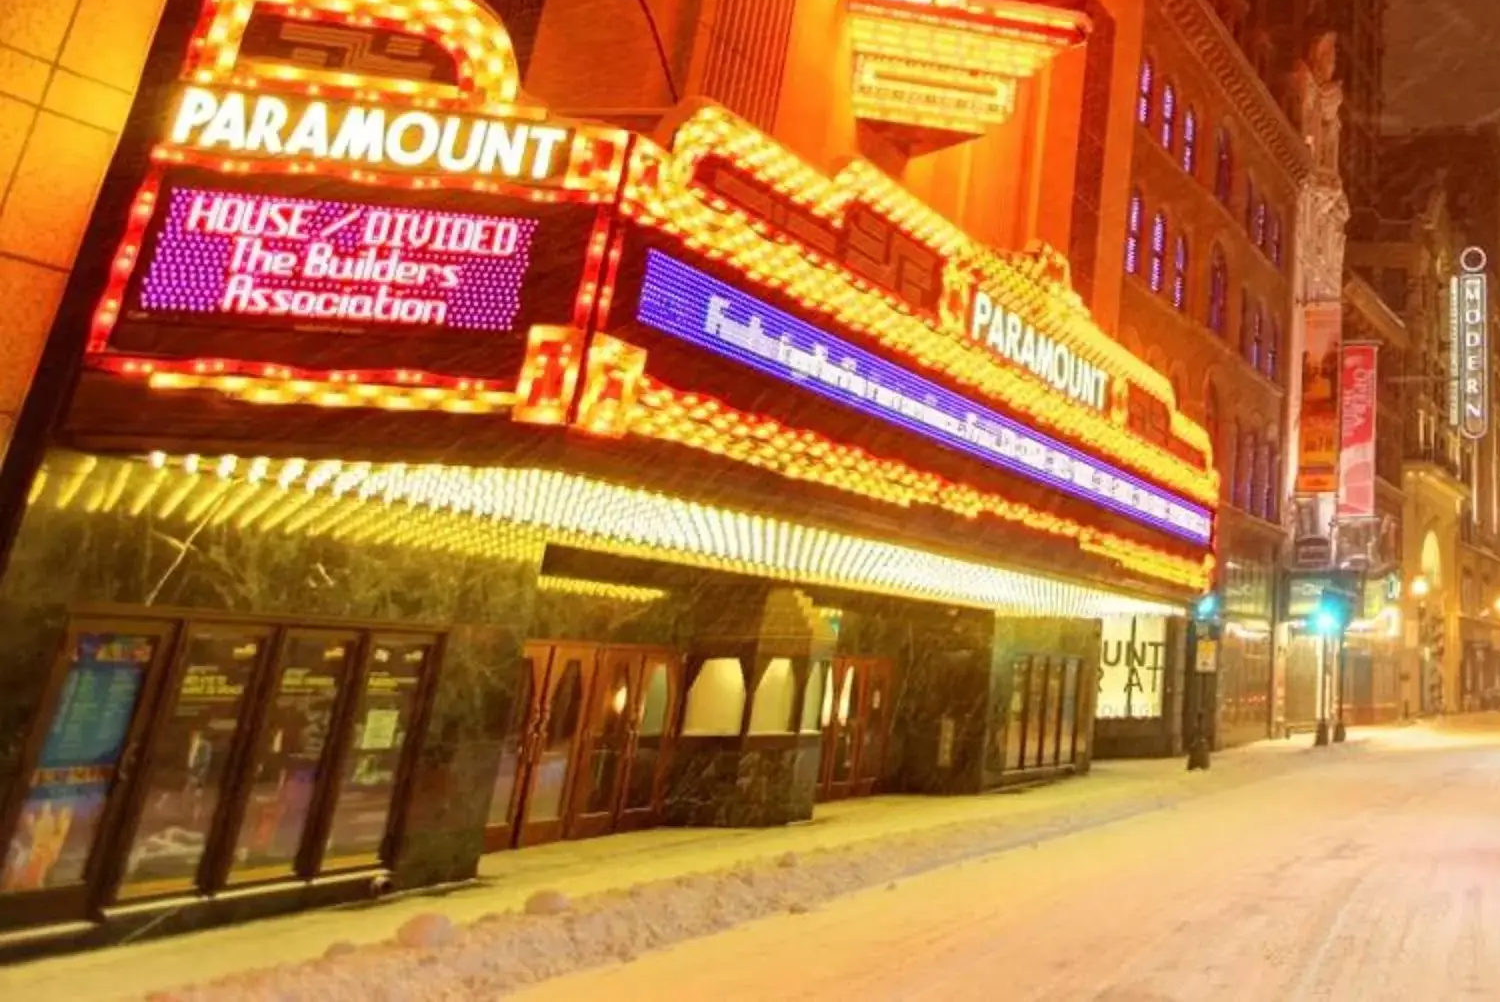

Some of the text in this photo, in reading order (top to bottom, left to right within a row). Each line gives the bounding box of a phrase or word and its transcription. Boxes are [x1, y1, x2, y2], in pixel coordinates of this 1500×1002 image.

[171, 86, 567, 178] PARAMOUNT
[187, 197, 319, 238] HOUSE
[364, 209, 519, 256] DIVIDED
[228, 237, 460, 288] The Builders
[223, 275, 448, 324] Association
[972, 291, 1109, 410] PARAMOUNT
[1464, 286, 1481, 418] MODERN
